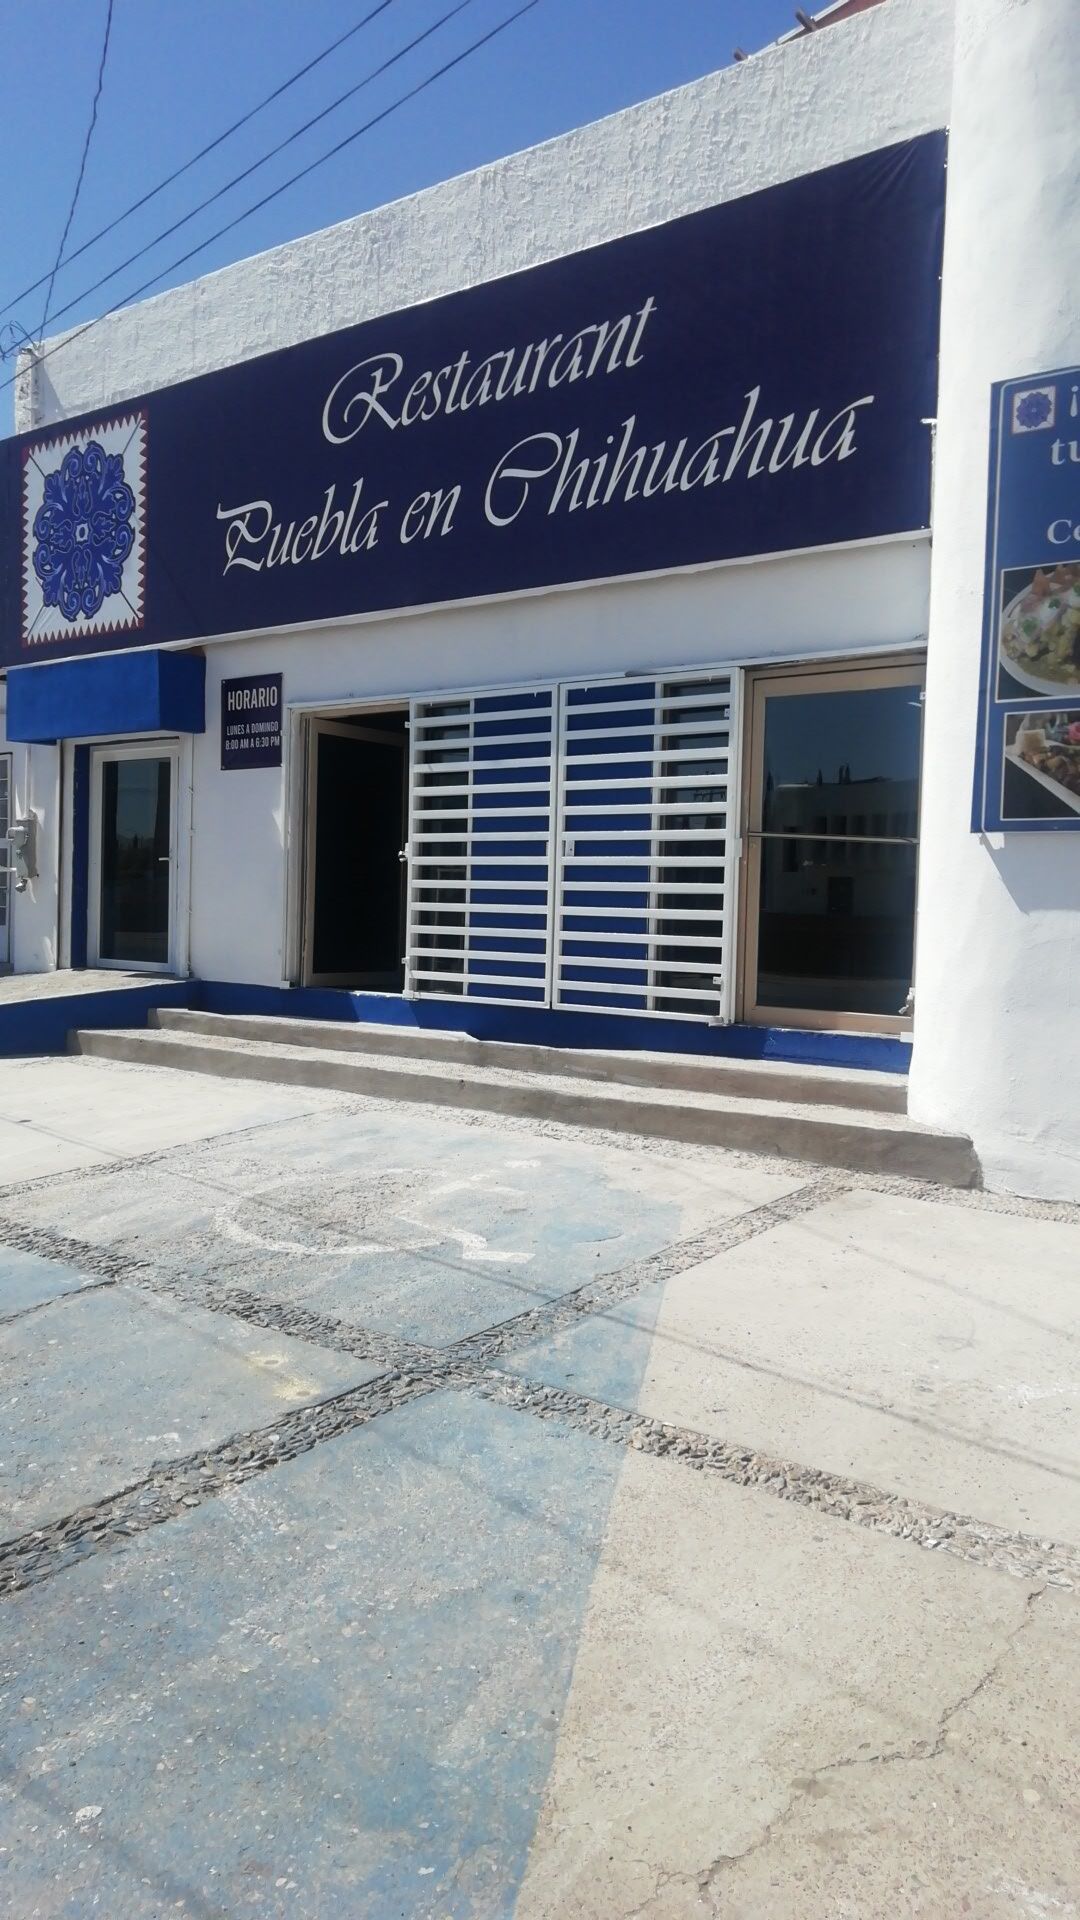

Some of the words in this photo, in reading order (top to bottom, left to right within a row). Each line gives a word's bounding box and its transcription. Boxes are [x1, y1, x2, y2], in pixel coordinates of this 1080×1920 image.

[322, 296, 657, 444] Restaurant
[216, 477, 389, 576] Puebla
[400, 485, 461, 544] en
[484, 385, 875, 527] Chihuahua
[227, 686, 278, 711] HORARIO
[226, 724, 245, 736] LUNES
[246, 723, 250, 734] A
[251, 721, 279, 734] DOMINGO
[225, 739, 239, 750] 8:00
[240, 738, 249, 749] AM
[250, 738, 255, 748] A
[255, 737, 269, 748] 6:30
[270, 735, 280, 747] PM
